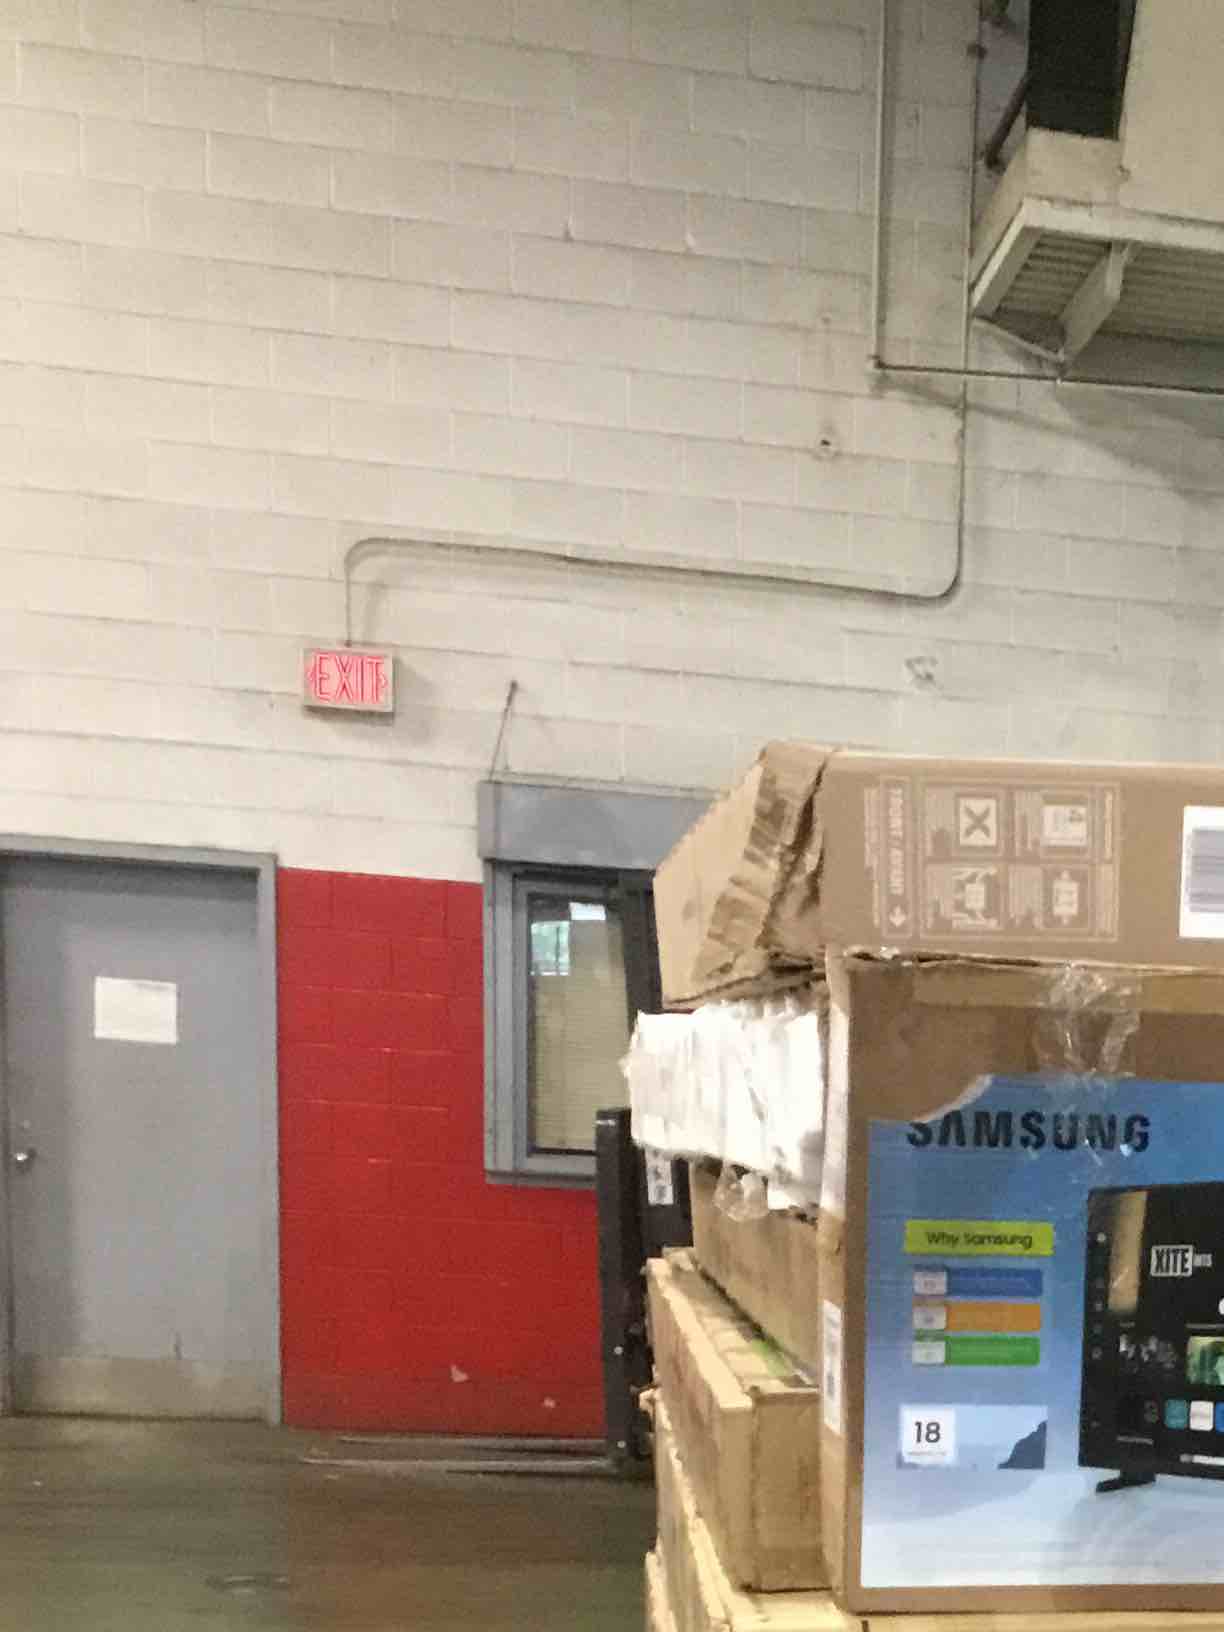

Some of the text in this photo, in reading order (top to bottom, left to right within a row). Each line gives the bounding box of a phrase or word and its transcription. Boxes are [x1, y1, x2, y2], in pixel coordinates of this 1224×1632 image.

[316, 652, 385, 703] EXIT
[926, 1231, 1033, 1250] Why Samsung
[1154, 1248, 1190, 1275] XITE
[913, 1421, 942, 1444] 18
